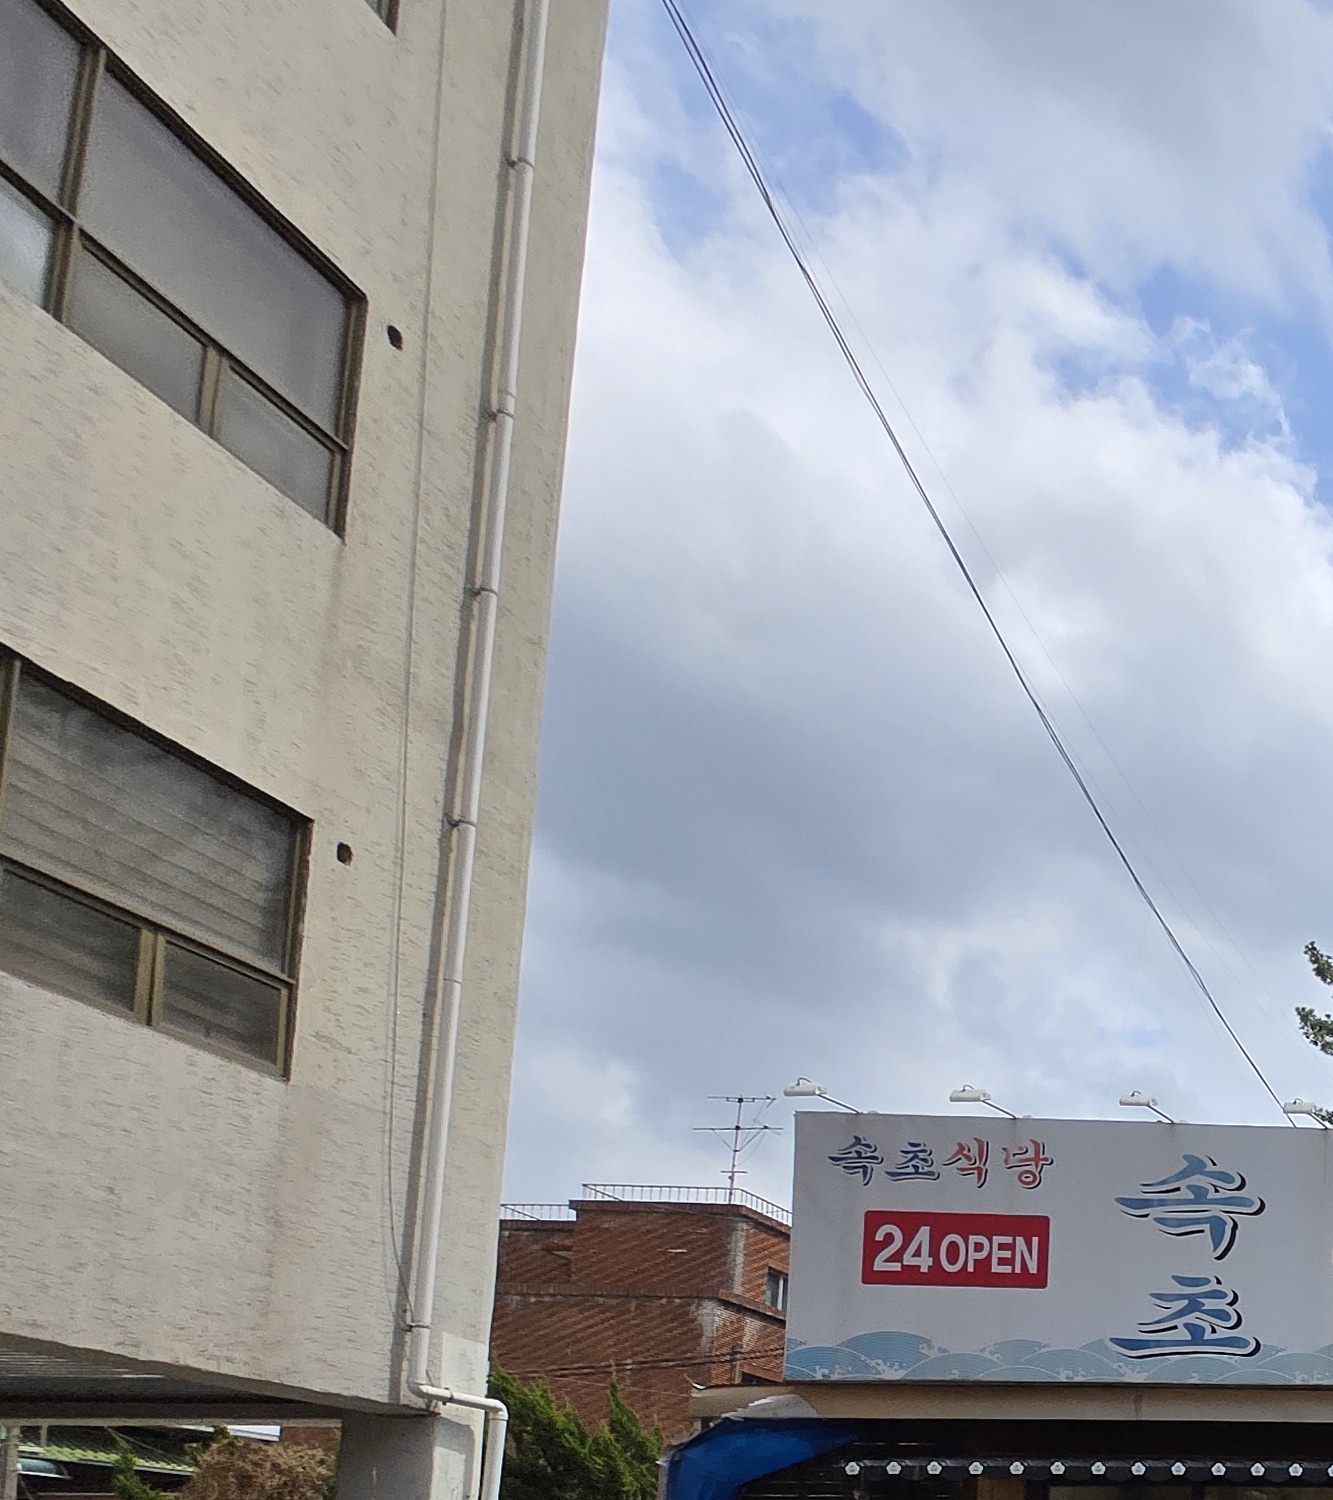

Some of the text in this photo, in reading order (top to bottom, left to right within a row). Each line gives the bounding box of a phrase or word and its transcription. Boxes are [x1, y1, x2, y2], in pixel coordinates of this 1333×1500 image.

[828, 1135, 1053, 1189] 속초식당
[938, 1233, 1039, 1275] OPEN
[1109, 1153, 1266, 1360] 속초
